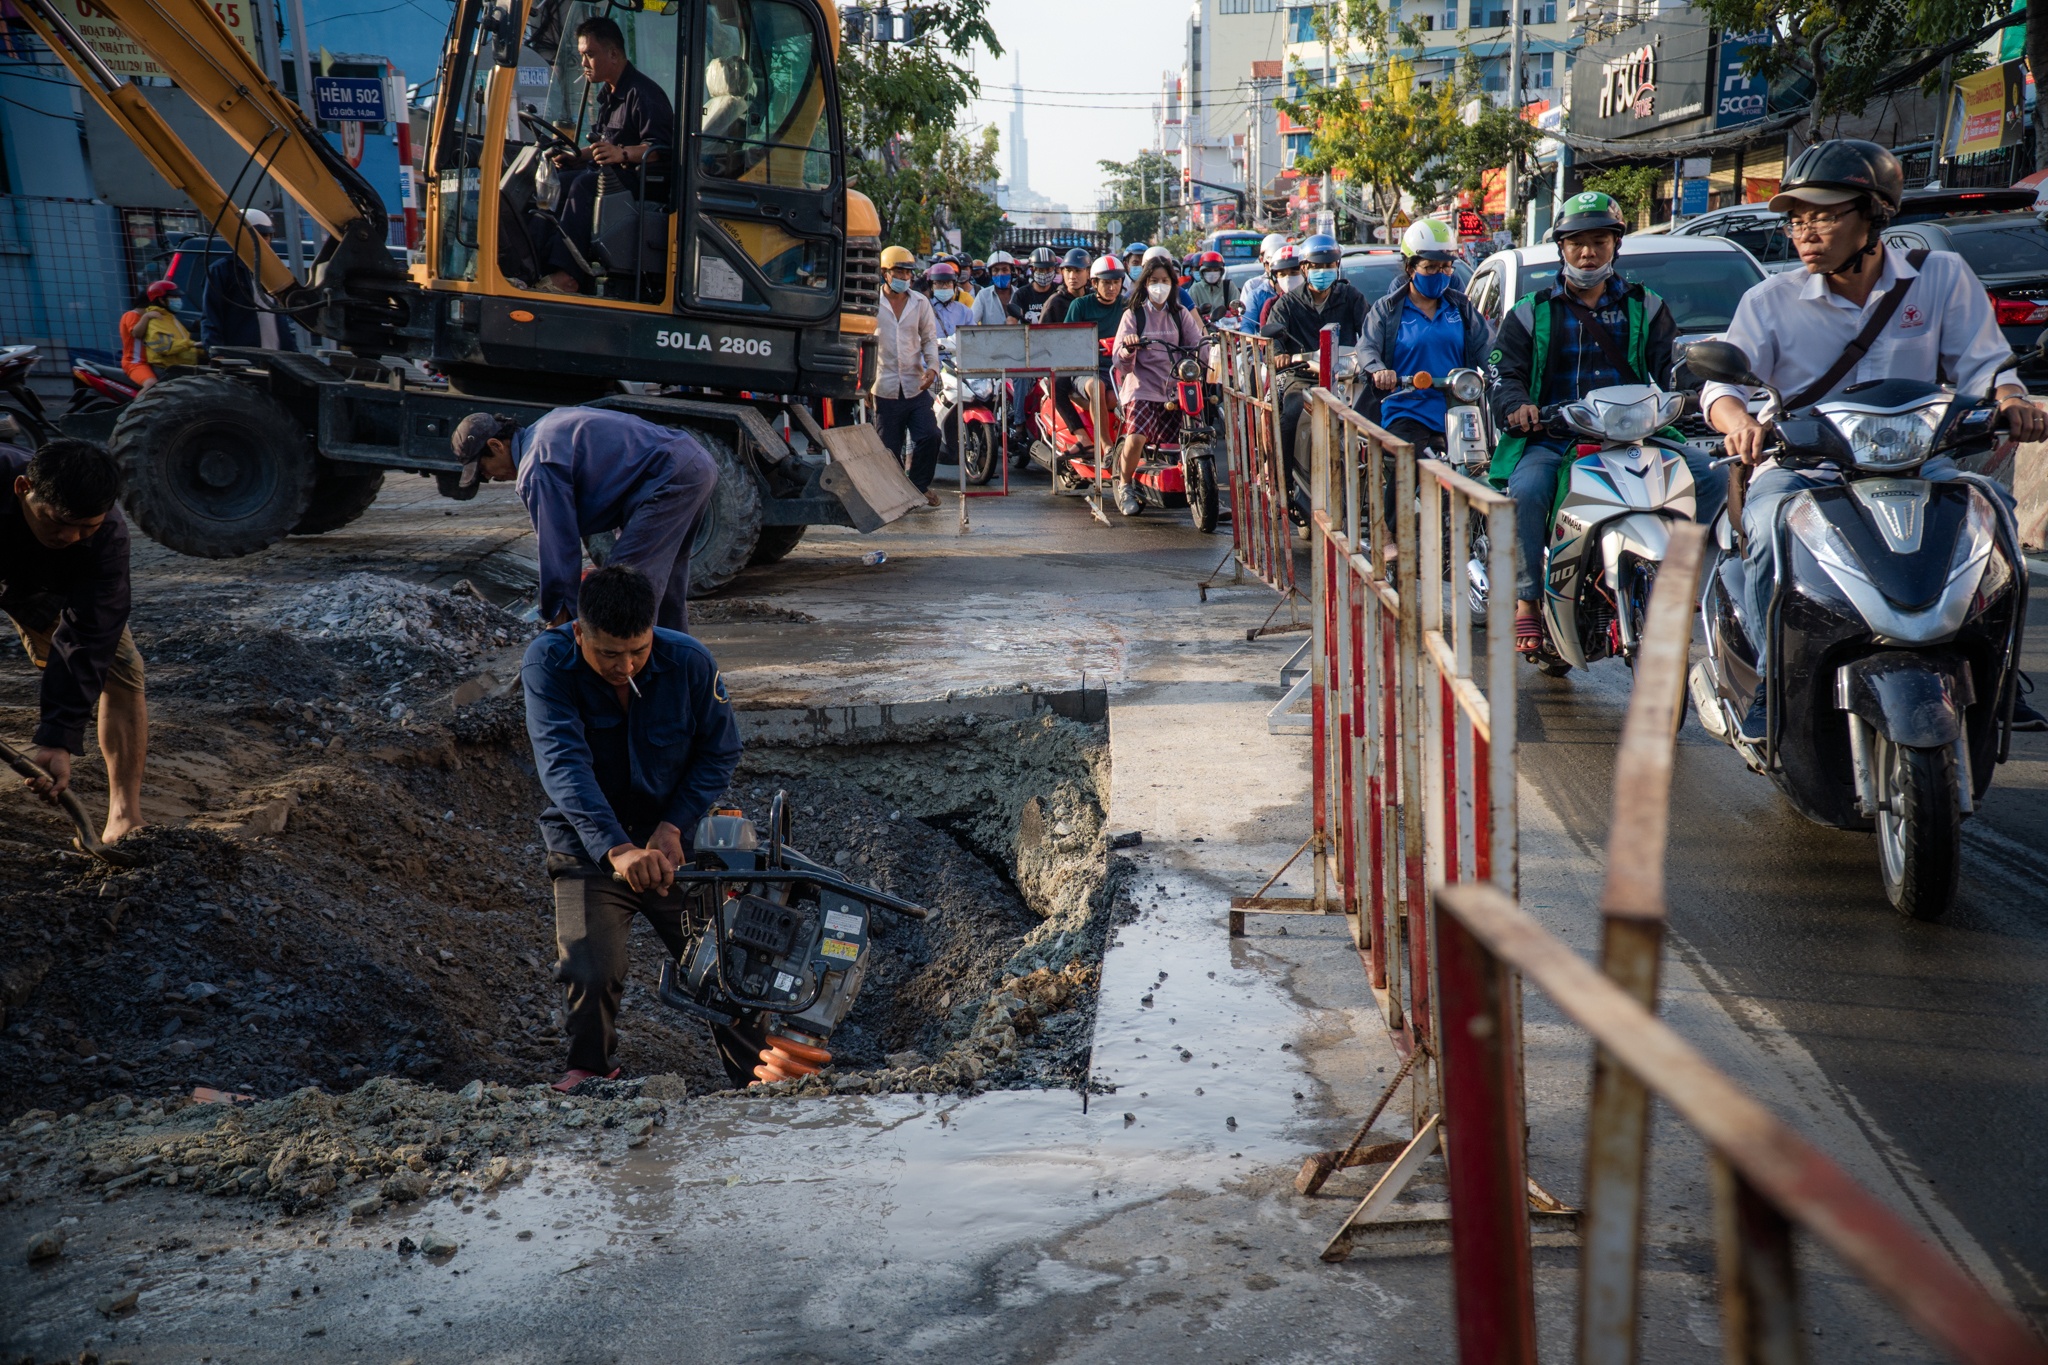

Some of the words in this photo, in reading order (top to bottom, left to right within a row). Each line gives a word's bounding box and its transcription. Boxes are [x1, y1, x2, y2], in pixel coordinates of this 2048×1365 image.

[79, 24, 106, 38] HOẠT
[320, 82, 352, 102] HẺM
[356, 88, 380, 103] 502
[656, 330, 712, 352] 50LA
[719, 336, 772, 357] 2806
[1871, 490, 1921, 499] HONDA
[1561, 512, 1582, 533] YAMAHA
[1549, 564, 1576, 585] 110
